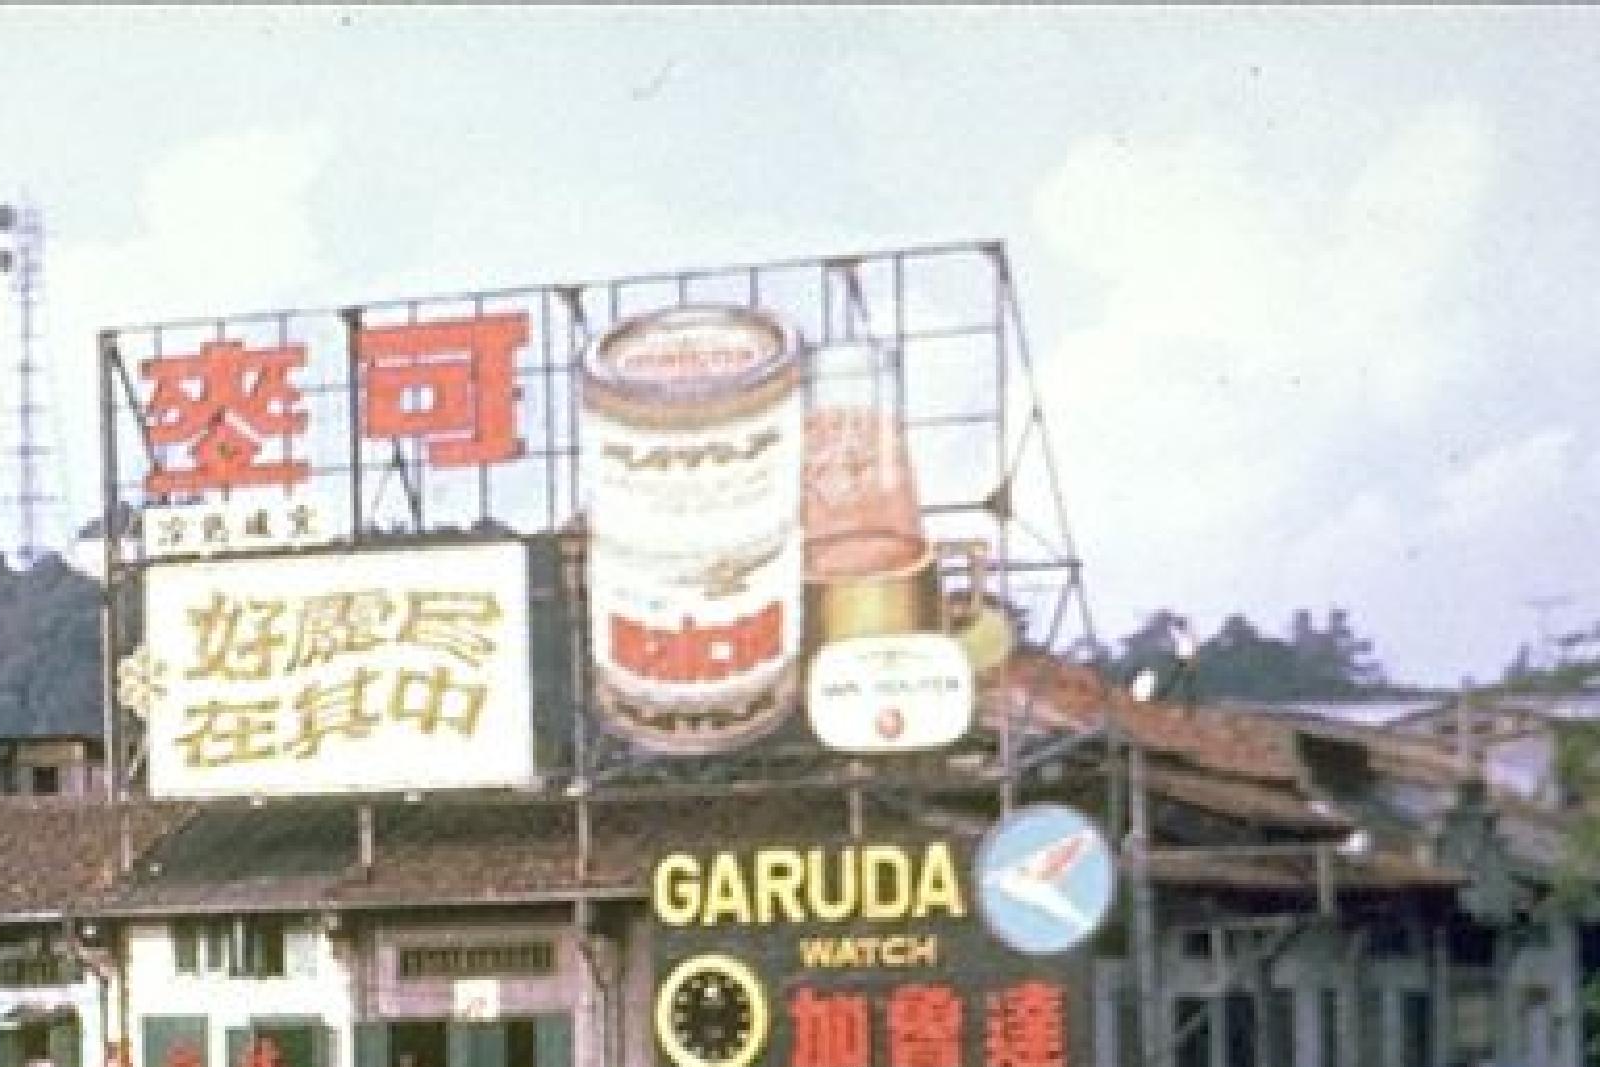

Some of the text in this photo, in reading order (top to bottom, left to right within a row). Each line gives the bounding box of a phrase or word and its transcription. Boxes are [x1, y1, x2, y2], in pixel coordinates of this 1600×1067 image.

[172, 666, 488, 768] 在其中
[654, 841, 968, 926] GARUDA
[799, 934, 939, 967] WATCH
